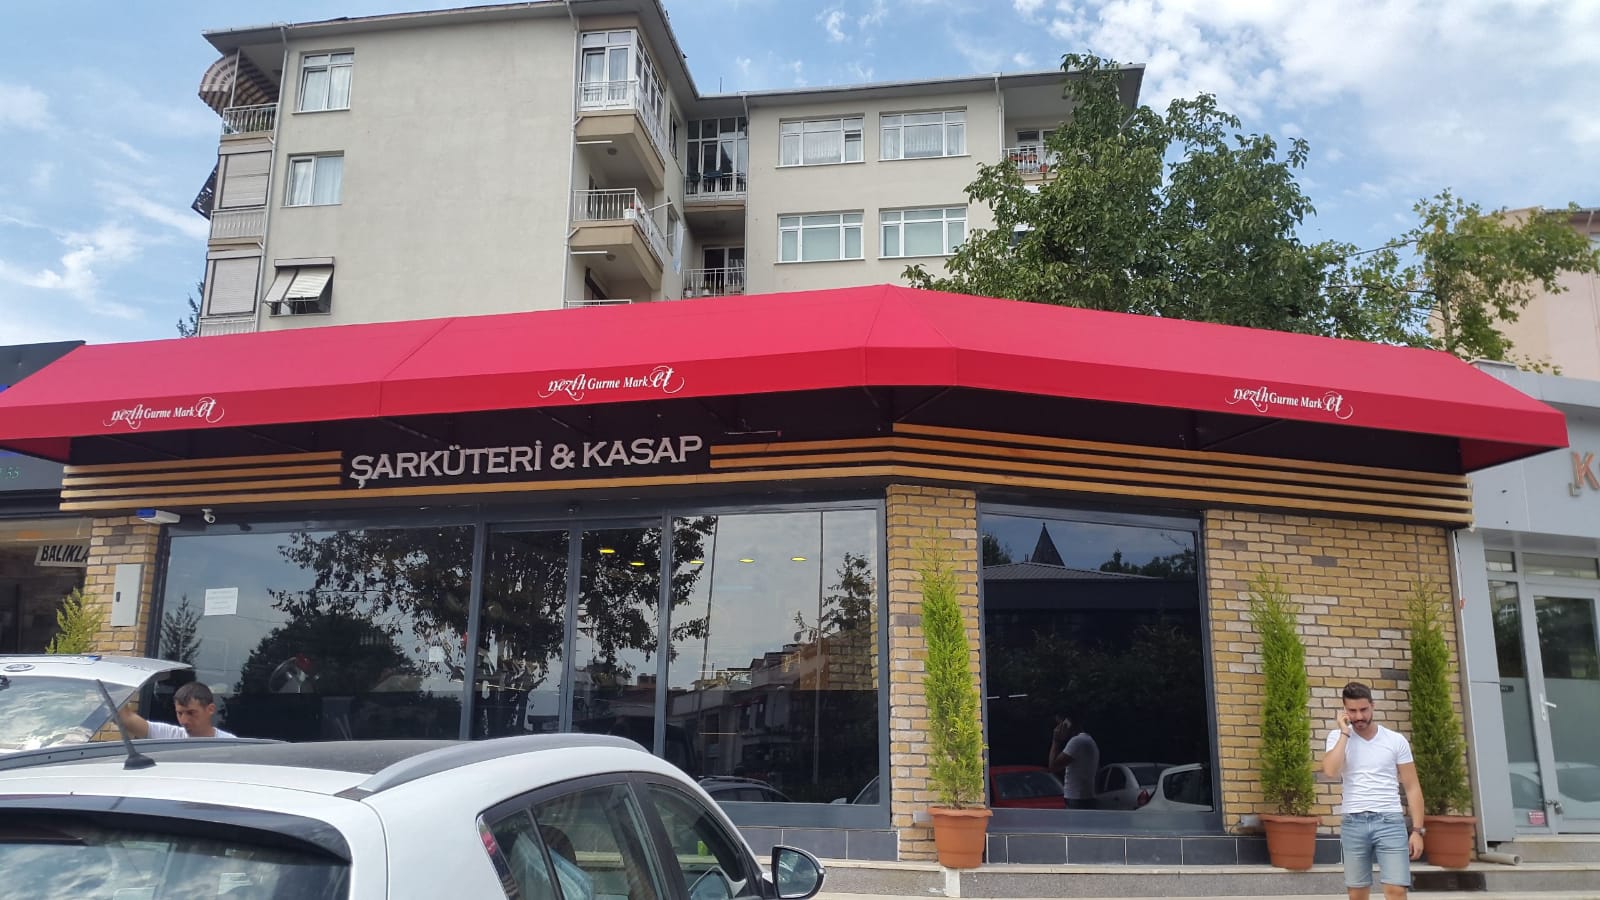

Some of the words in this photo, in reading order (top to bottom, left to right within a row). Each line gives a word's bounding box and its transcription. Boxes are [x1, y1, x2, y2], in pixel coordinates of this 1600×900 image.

[587, 377, 620, 390] Gurme
[1269, 392, 1299, 406] Gurme
[144, 408, 171, 419] Gurme
[349, 439, 543, 489] ŞARKÜTERİ
[550, 443, 576, 469] &
[582, 435, 703, 469] KASAP
[1570, 451, 1600, 490] K
